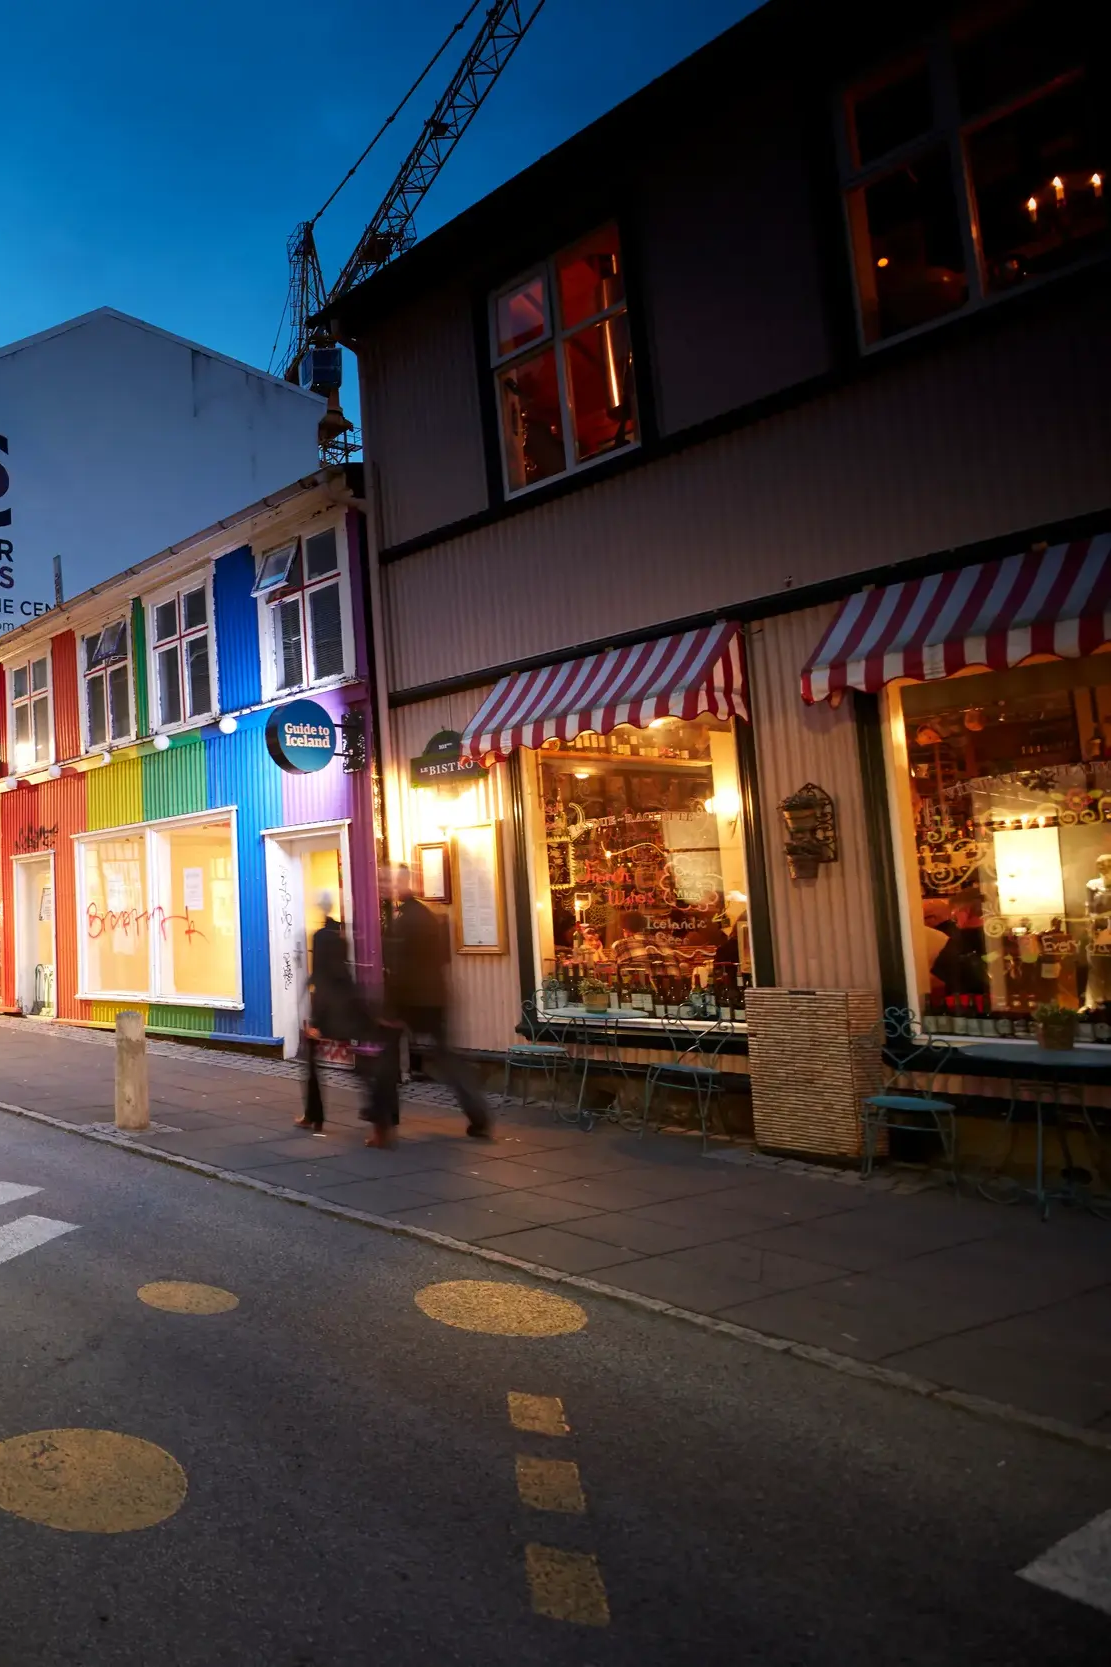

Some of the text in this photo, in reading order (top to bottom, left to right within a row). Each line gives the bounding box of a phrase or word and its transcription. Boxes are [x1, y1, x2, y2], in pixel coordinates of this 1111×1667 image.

[284, 722, 330, 736] Guide to
[285, 734, 331, 748] Iceland
[645, 914, 708, 931] Icelandic
